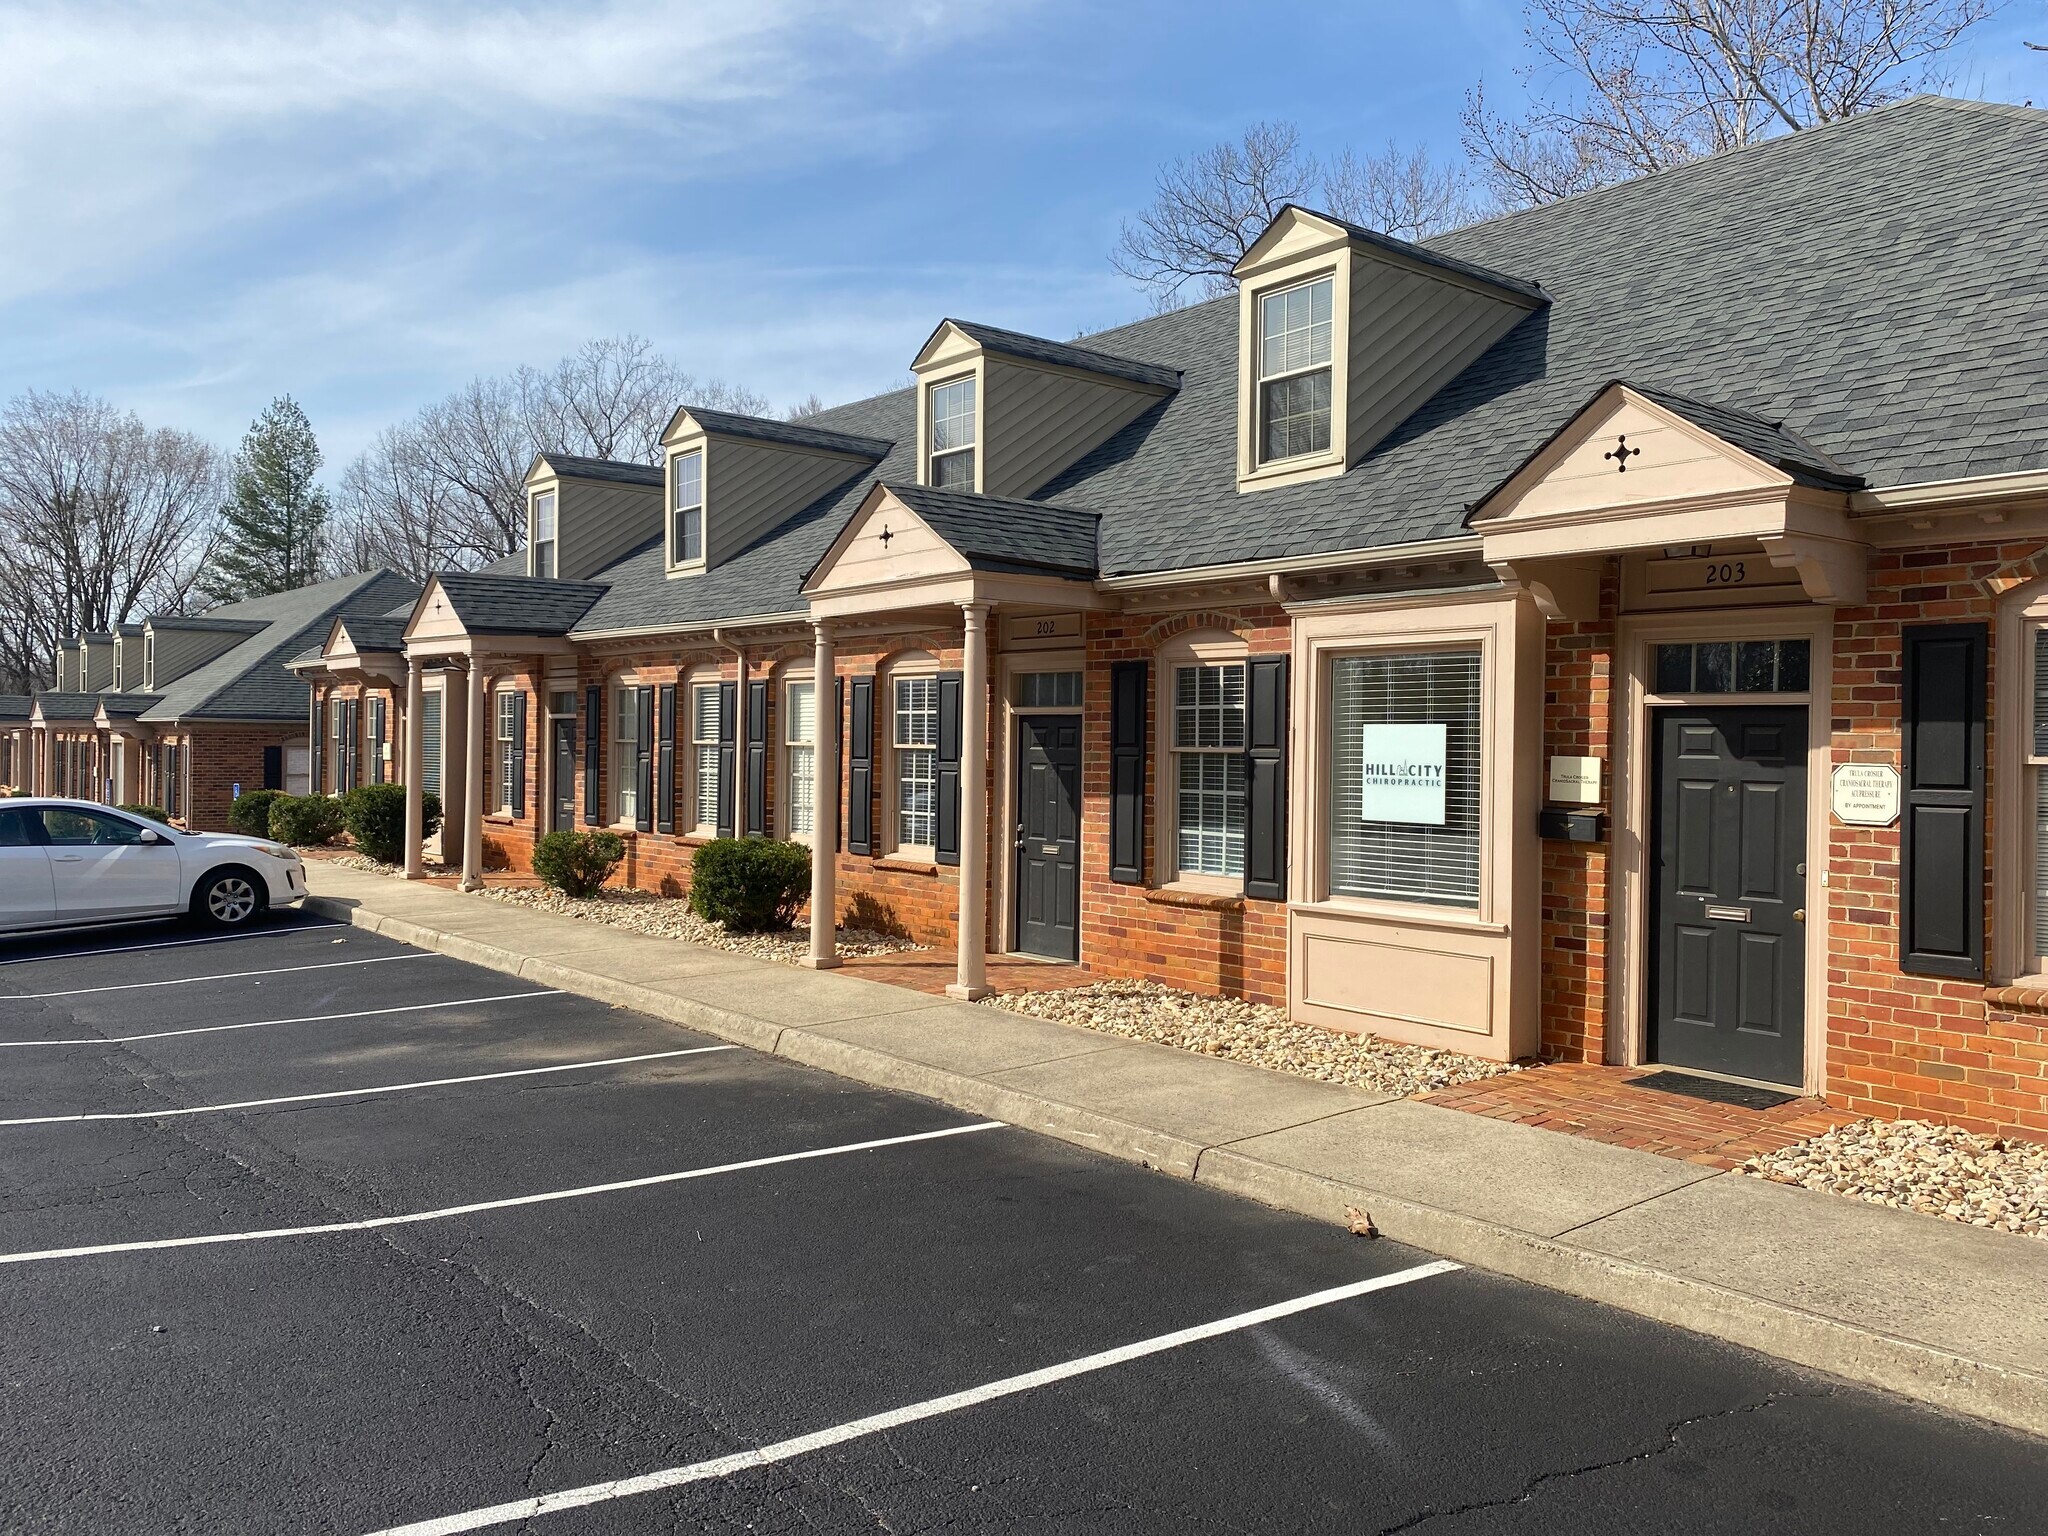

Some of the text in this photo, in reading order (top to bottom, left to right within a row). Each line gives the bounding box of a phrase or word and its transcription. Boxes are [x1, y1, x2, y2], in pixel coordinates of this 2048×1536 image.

[1706, 562, 1745, 584] 203
[1036, 620, 1055, 635] 202
[1366, 764, 1442, 777] HILL CITY
[1366, 777, 1442, 787] CHIROPRACTIC
